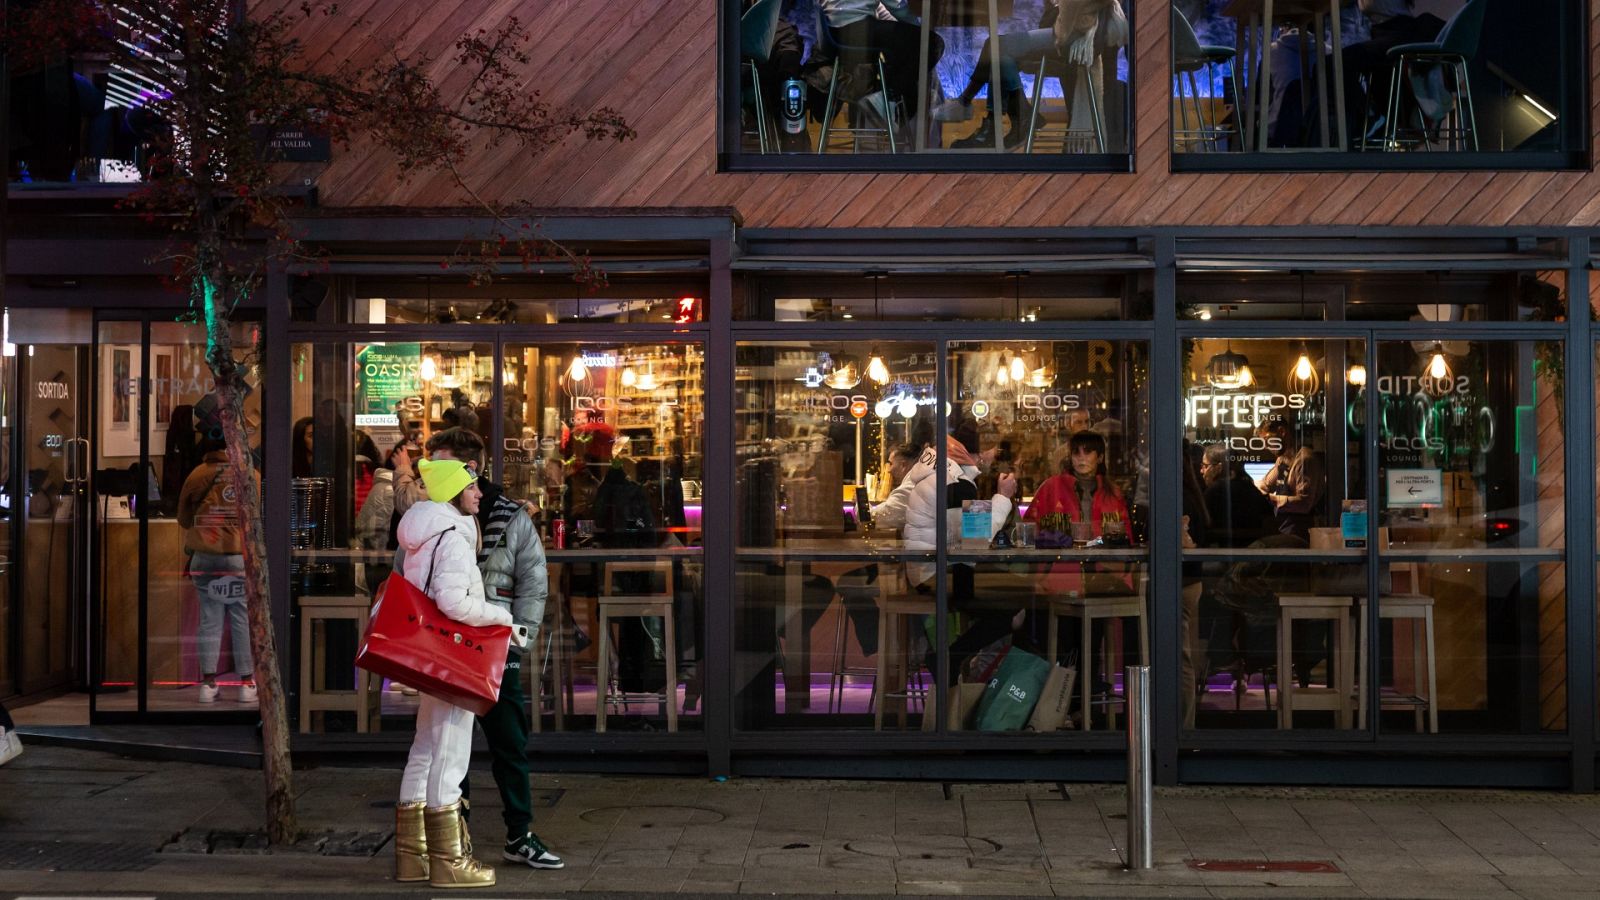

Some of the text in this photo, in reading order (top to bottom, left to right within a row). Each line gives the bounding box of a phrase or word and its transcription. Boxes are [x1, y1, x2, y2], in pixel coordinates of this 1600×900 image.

[284, 140, 312, 149] VALIRA
[365, 364, 417, 377] OASIS
[38, 381, 69, 399] SORTIDA
[570, 396, 633, 413] IQOS
[1017, 394, 1080, 411] IQOS
[1017, 414, 1057, 422] LOUNGE
[503, 438, 555, 453] QOS
[1225, 436, 1284, 453] IQOS
[1387, 436, 1444, 452] IQOS
[503, 456, 536, 464] OUNGE
[1225, 455, 1262, 463] LOUNGE
[1009, 684, 1027, 701] P&B
